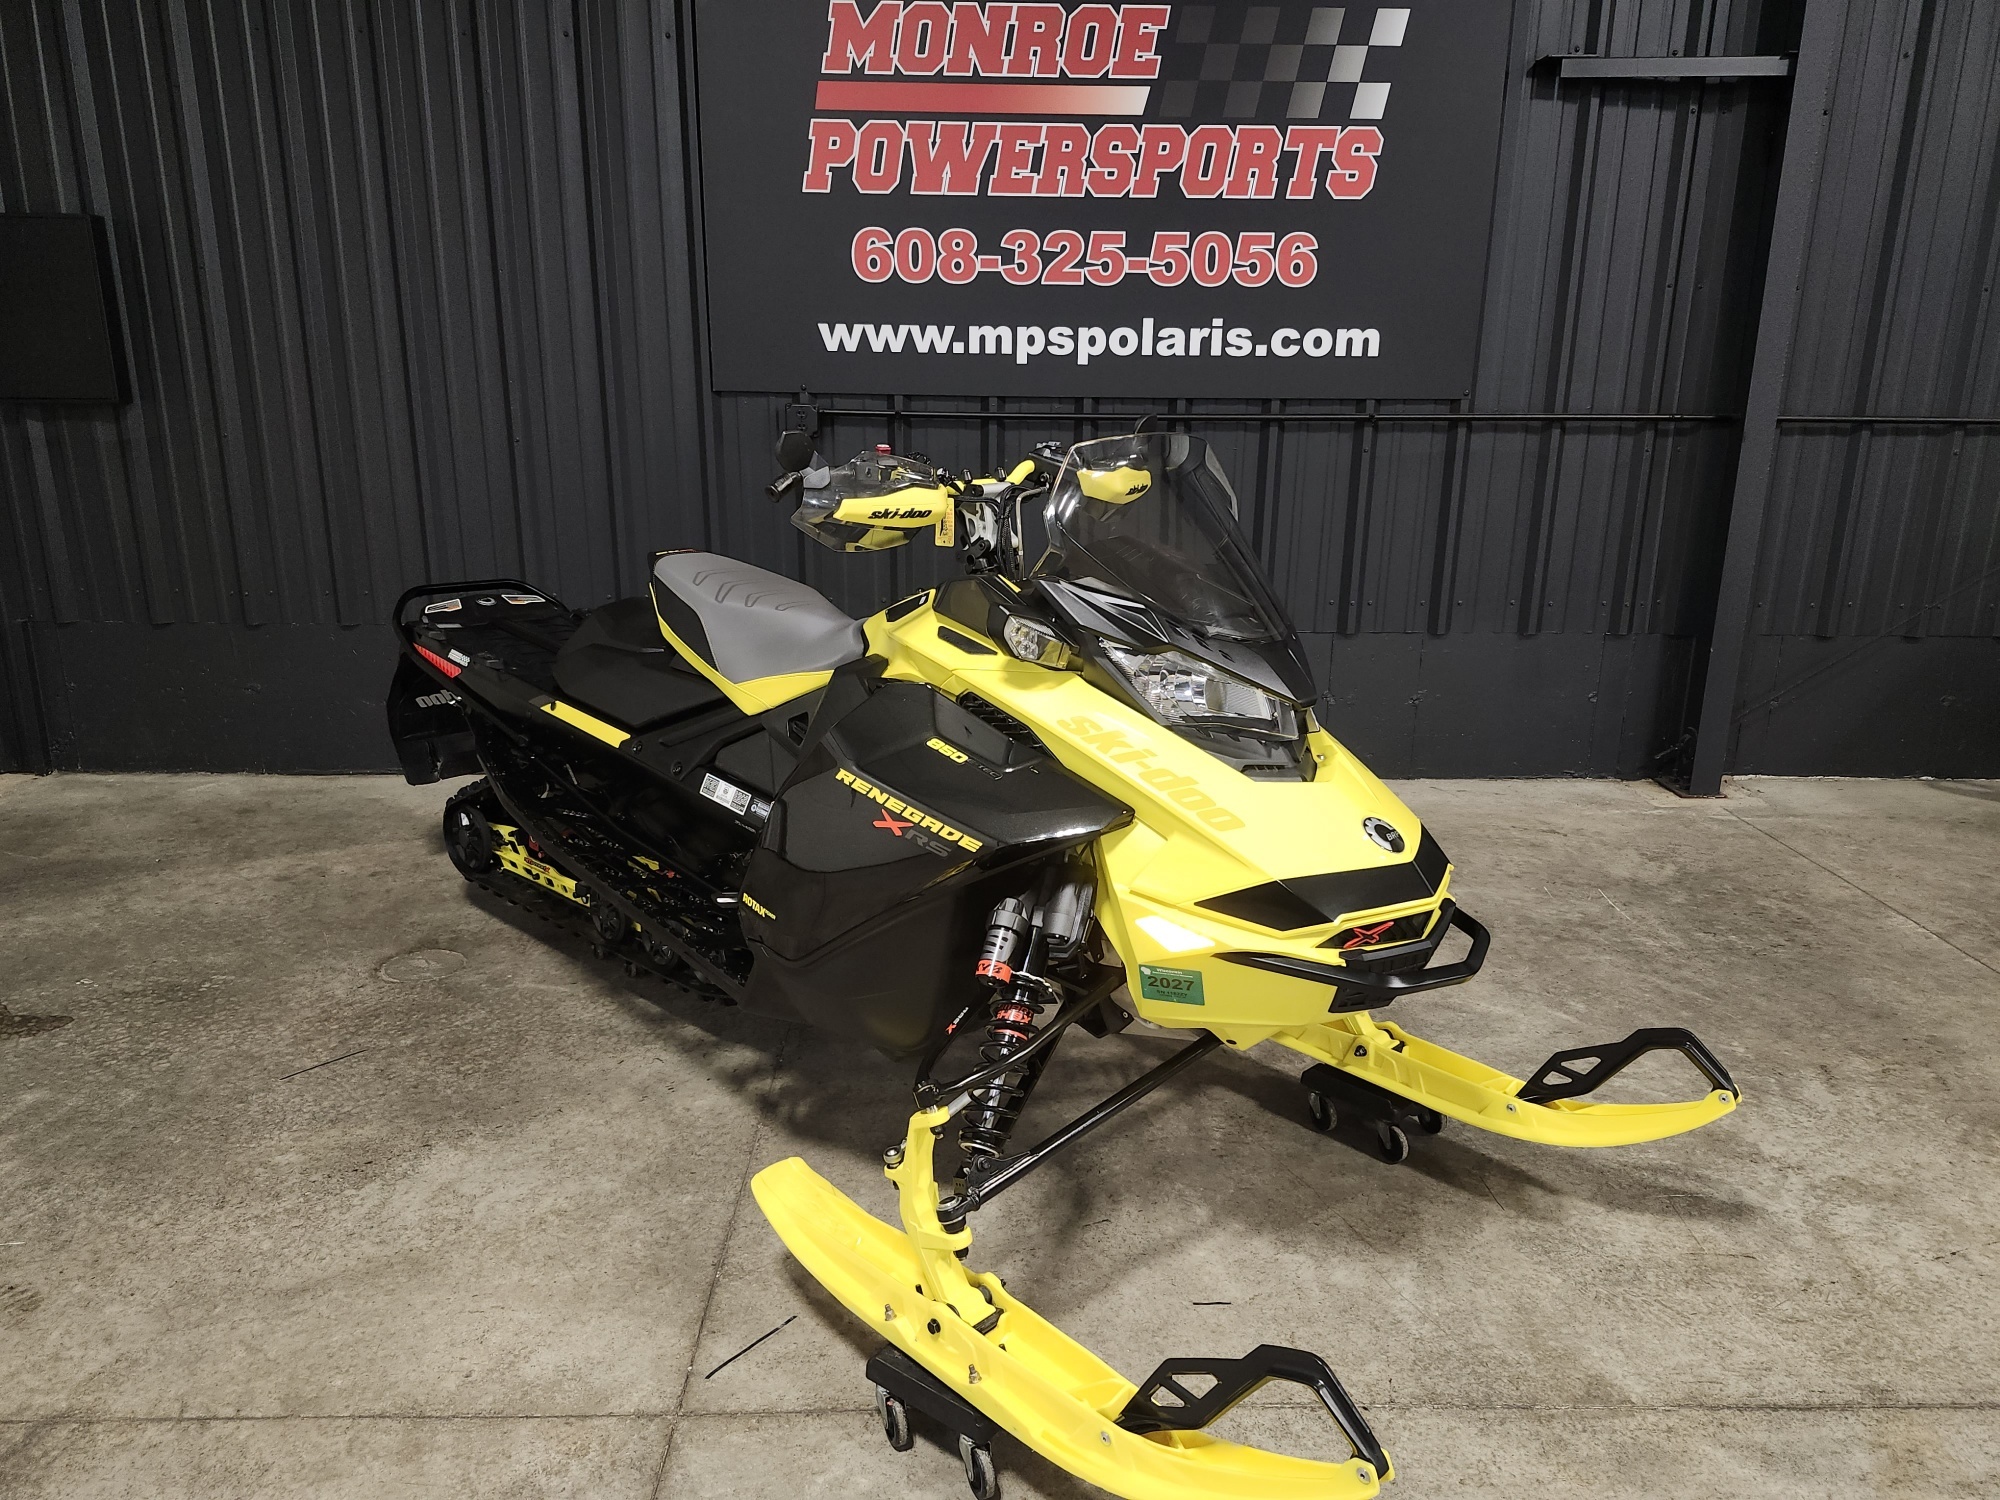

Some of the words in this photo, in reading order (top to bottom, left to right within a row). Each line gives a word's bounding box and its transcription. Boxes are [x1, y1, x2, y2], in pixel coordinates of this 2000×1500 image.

[822, 1, 1171, 78] MONROE
[802, 120, 1384, 200] POWERSPORTS
[851, 227, 1319, 287] 608-325-5056
[818, 317, 1381, 365] www.mpspolaris.com
[867, 507, 933, 520] ski-doo
[925, 737, 969, 763] 850
[1056, 715, 1246, 832] ski-doo
[835, 768, 983, 853] RENEGADE
[904, 829, 951, 858] RS
[742, 892, 766, 918] ROTAX
[1147, 976, 1195, 991] 2027
